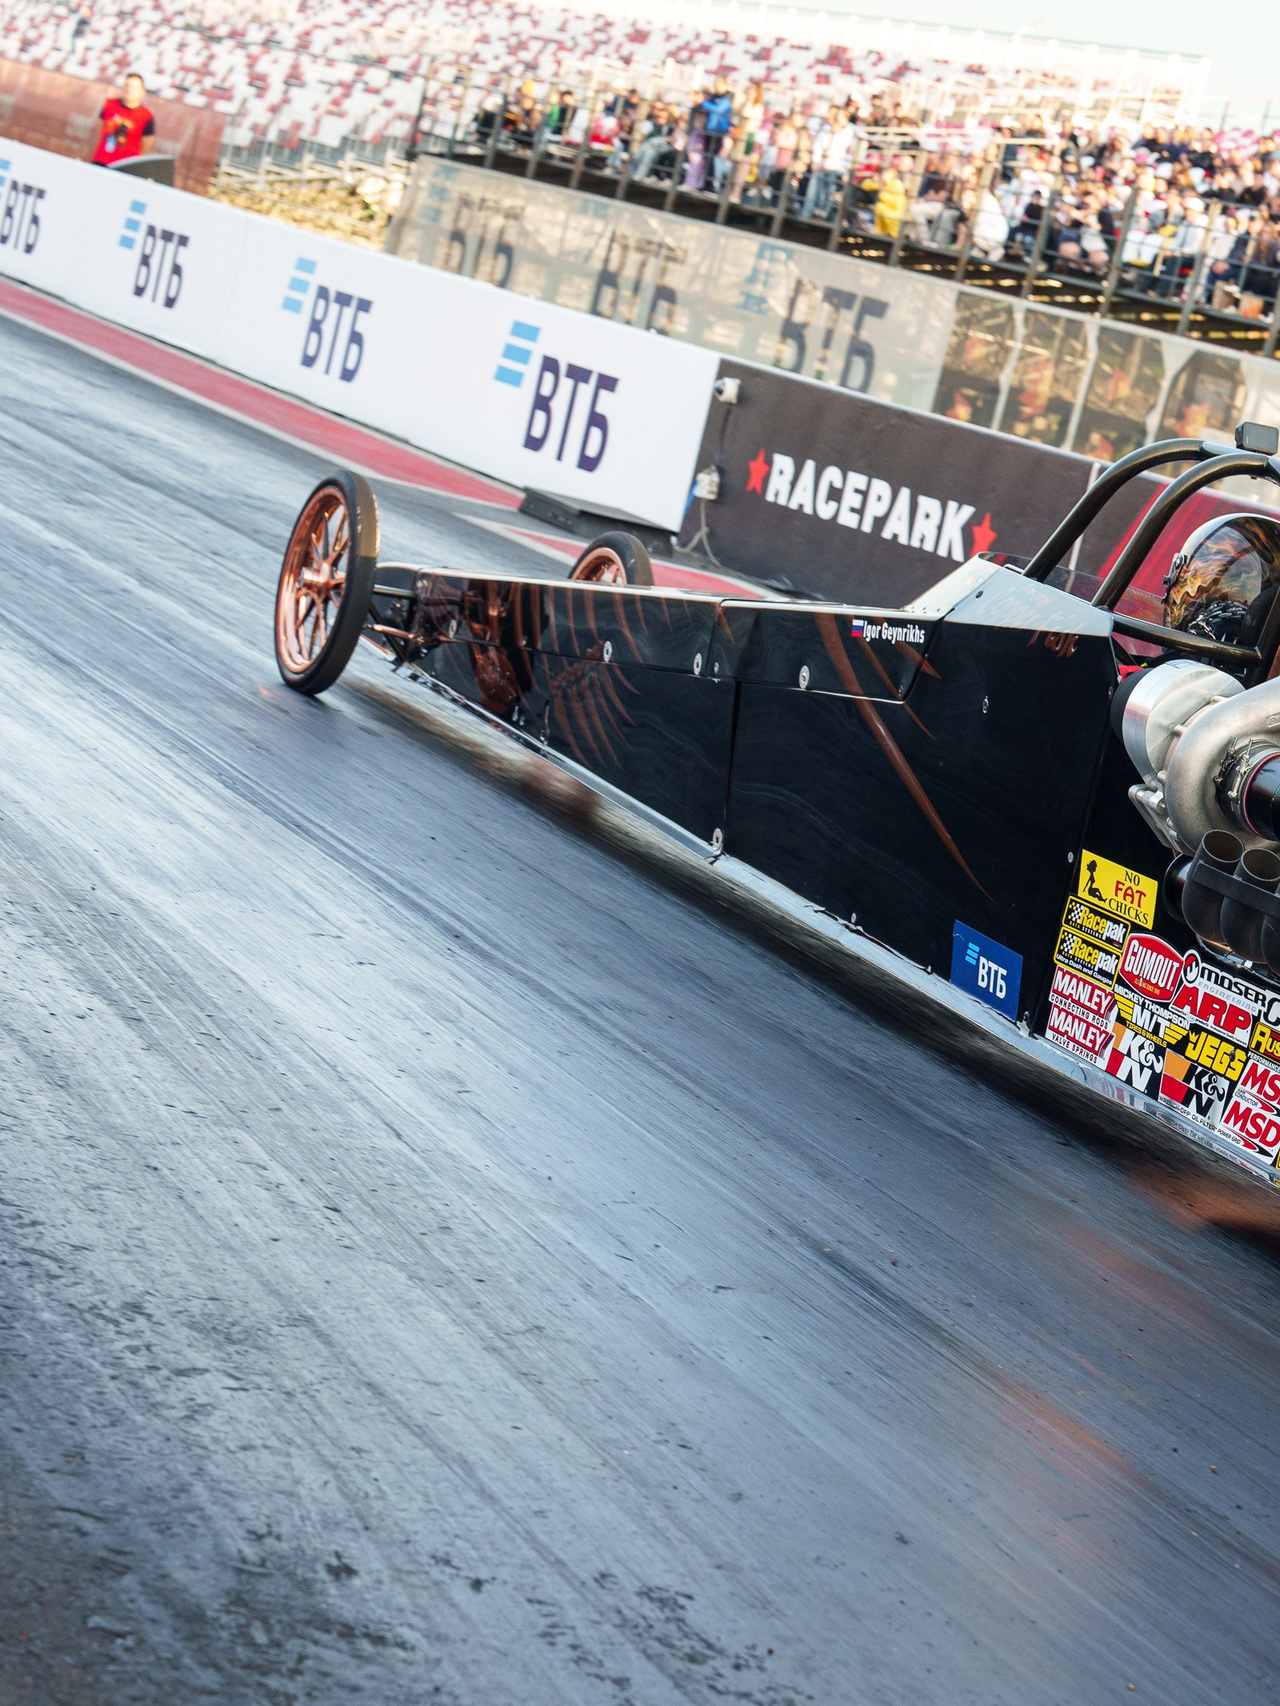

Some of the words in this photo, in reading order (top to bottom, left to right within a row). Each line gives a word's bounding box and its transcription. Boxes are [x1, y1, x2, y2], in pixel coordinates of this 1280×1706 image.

[0, 180, 46, 254] ВТБ
[133, 224, 189, 308] ВТБ
[301, 285, 373, 382] ВТБ
[523, 355, 620, 472] ВТБ
[765, 453, 976, 563] RACEPARK
[863, 620, 881, 642] Igor
[881, 622, 925, 644] Geynrikhs
[1115, 880, 1146, 908] FAT
[1124, 870, 1141, 887] NO
[1080, 907, 1126, 943] Racepak
[1109, 898, 1149, 924] CHICKS
[1069, 960, 1082, 971] Dash
[1093, 971, 1112, 985] Gauges
[1072, 938, 1118, 974] Racepak
[1124, 939, 1179, 991] GUMOUT
[978, 956, 1008, 999] ВТБ
[1053, 970, 1111, 1014] MANLEY
[1051, 993, 1090, 1019] CONNECTING
[1092, 1015, 1108, 1029] RODS
[1114, 984, 1145, 1005] MICKEY
[1145, 1000, 1190, 1030] THOMPSON
[1132, 1004, 1171, 1038] M/T
[1172, 984, 1251, 1034] ARP
[1050, 1008, 1106, 1052] MANLEY
[1052, 1033, 1070, 1048] VALVE
[1072, 1044, 1097, 1064] SPRINGS
[1126, 1020, 1141, 1033] TIRES
[1147, 1031, 1167, 1048] WHEELS
[1185, 1031, 1247, 1081] JEGS
[1247, 1051, 1280, 1072] PERFORMANCE
